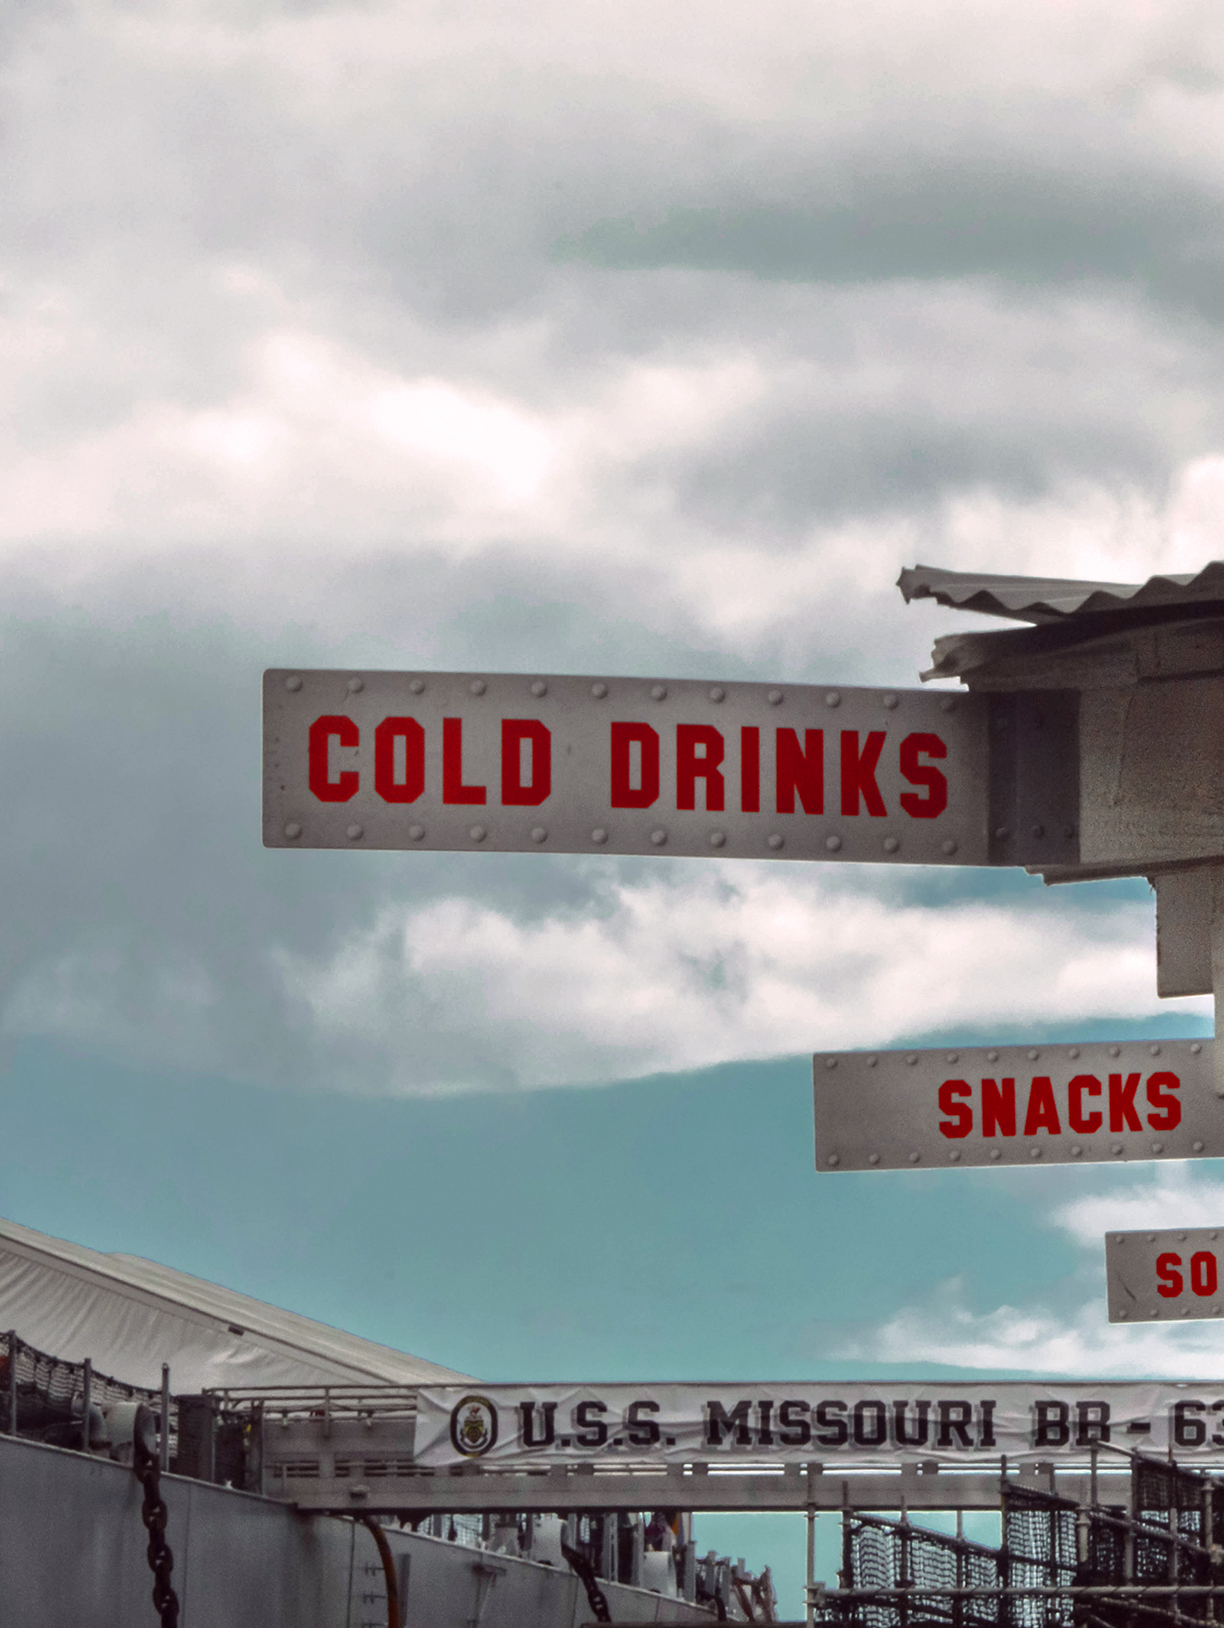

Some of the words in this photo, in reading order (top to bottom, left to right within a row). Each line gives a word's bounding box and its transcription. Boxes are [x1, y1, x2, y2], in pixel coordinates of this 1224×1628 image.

[309, 716, 552, 807] COLD
[610, 721, 948, 819] DRINKS
[938, 1071, 1182, 1139] SNACKS
[519, 1400, 677, 1448] U.S.S.
[705, 1400, 996, 1448] MISSOURI
